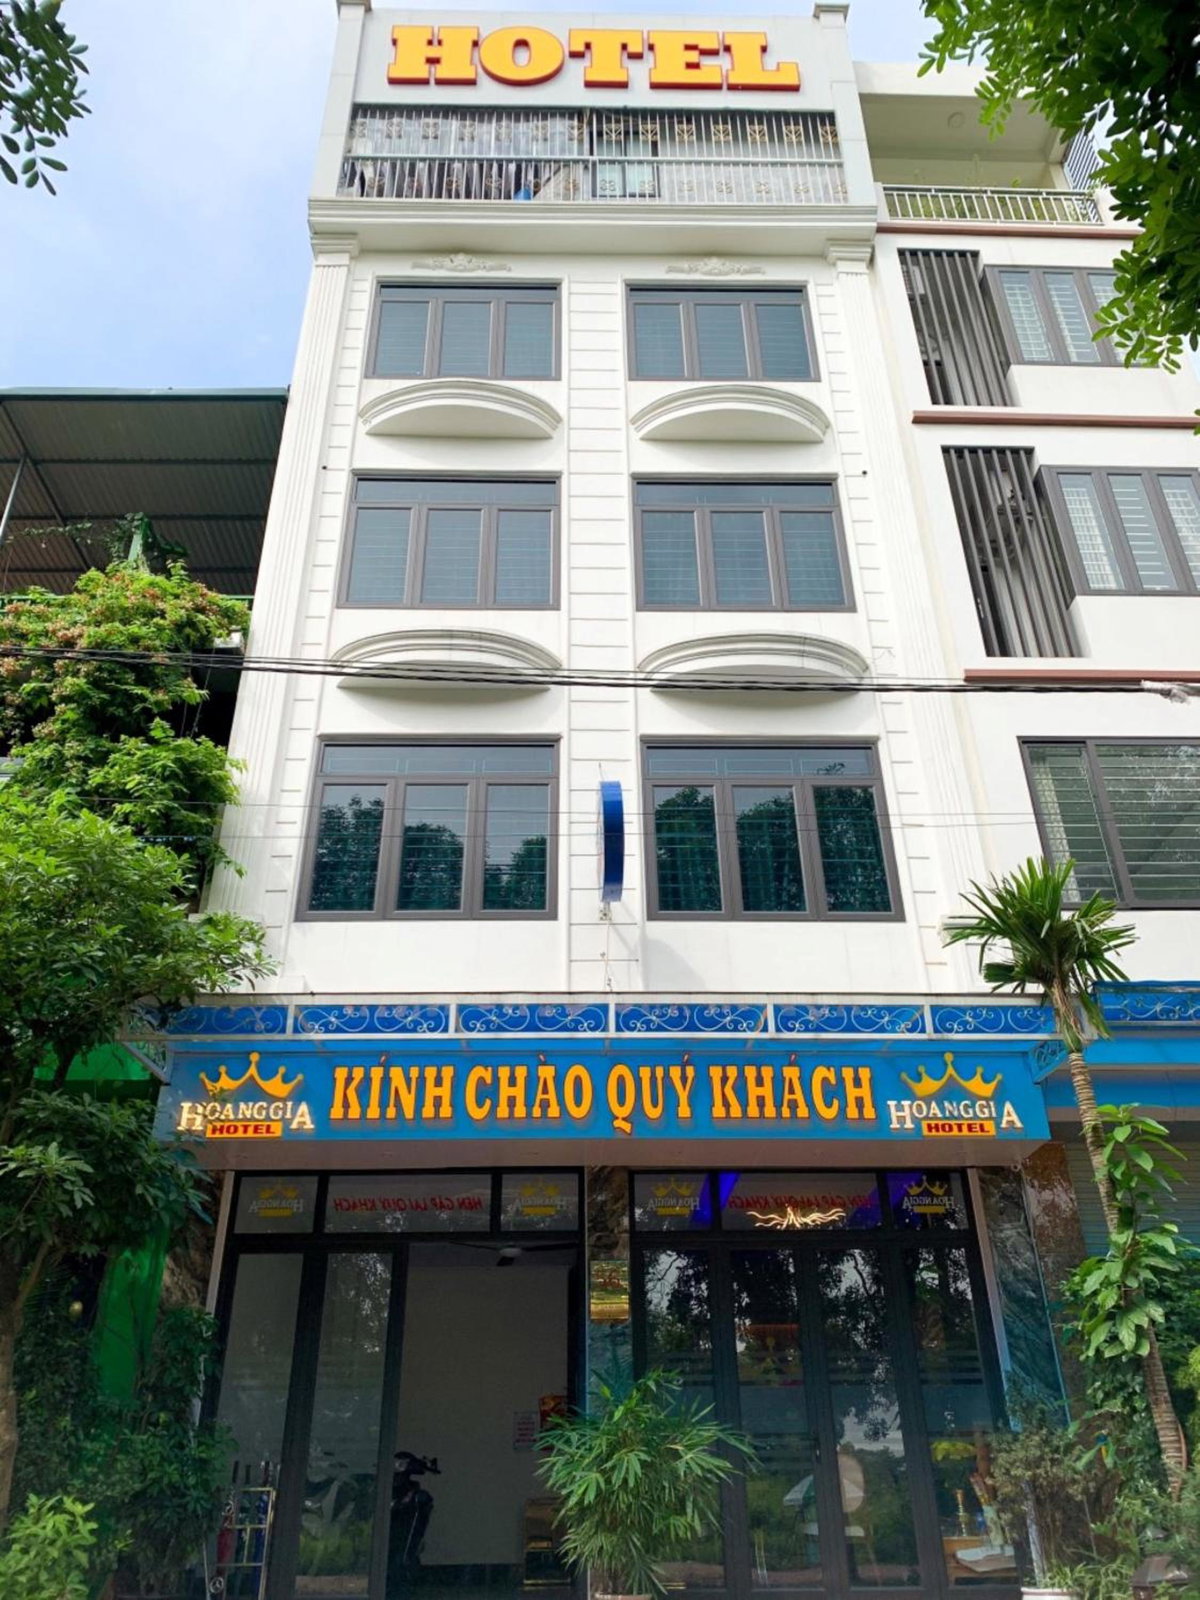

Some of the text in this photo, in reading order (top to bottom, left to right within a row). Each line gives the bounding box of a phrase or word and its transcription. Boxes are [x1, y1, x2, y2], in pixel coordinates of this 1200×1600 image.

[386, 24, 801, 92] HOTEL
[328, 1053, 877, 1135] KÍNH CHÀO QUÝ KHÁCH
[211, 1123, 276, 1136] HOTEL
[926, 1122, 990, 1134] HOTEL
